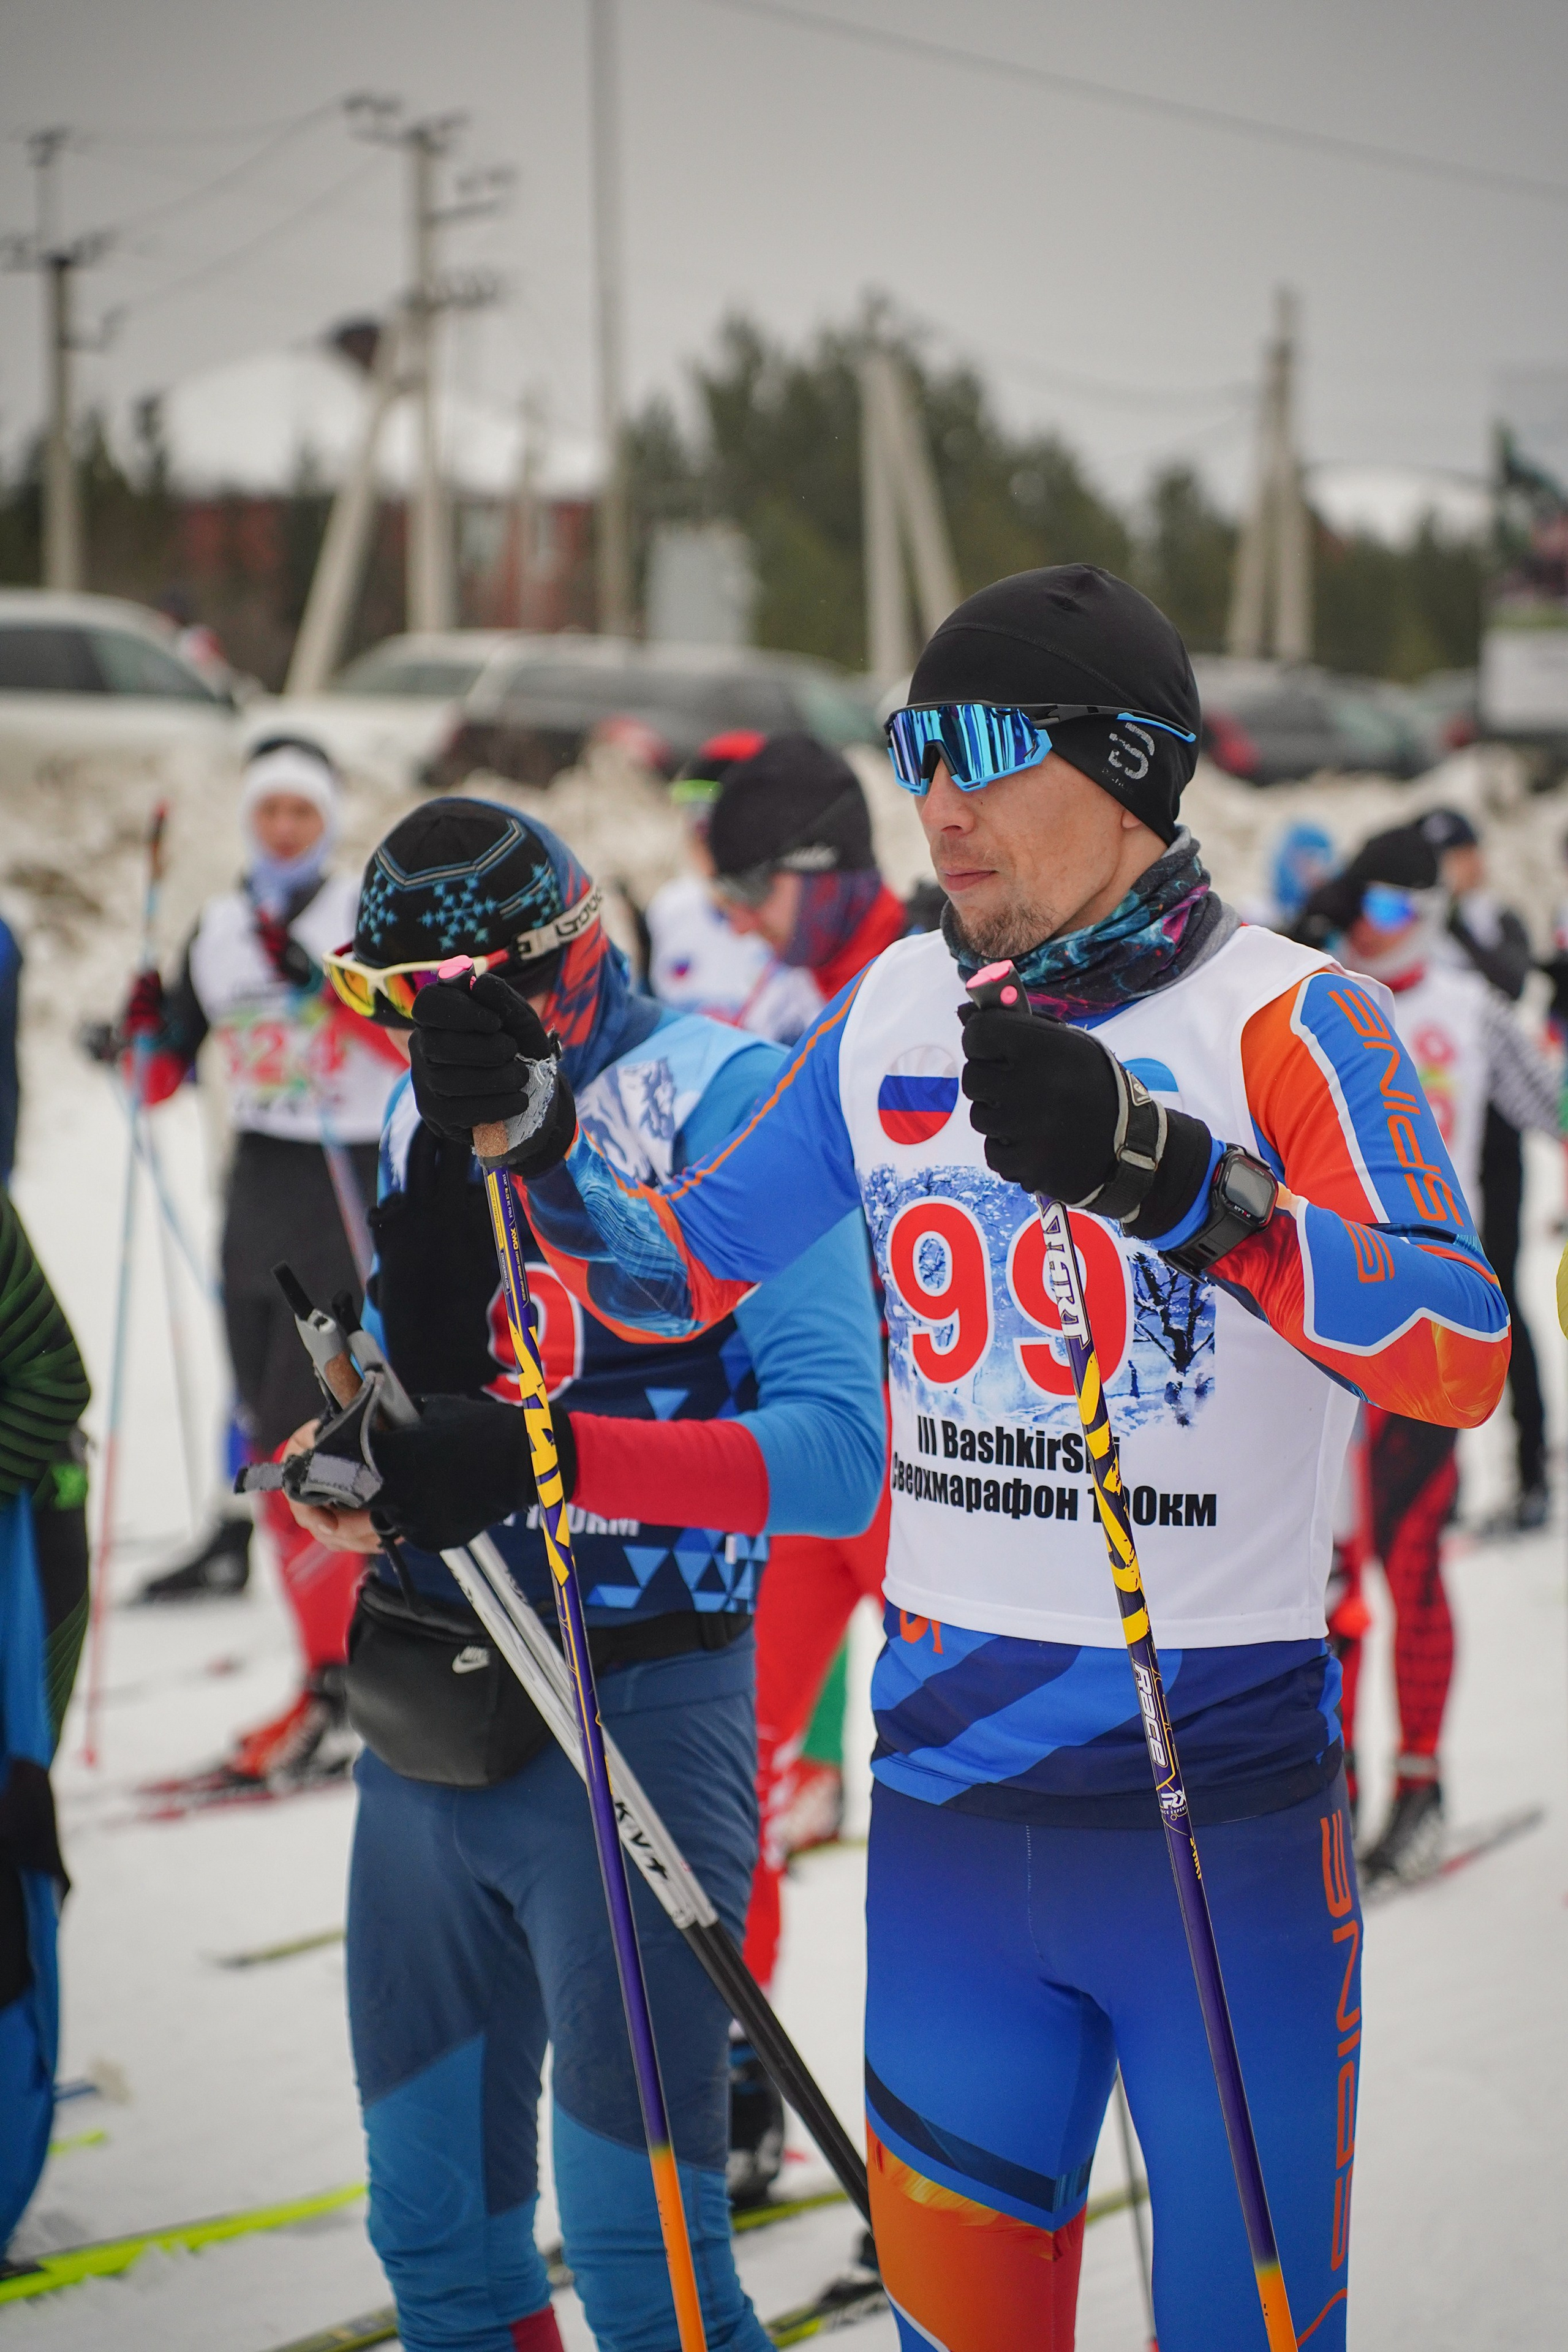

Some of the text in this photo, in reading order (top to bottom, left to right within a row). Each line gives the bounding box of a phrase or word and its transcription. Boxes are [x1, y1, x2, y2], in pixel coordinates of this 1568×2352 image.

[1233, 1204, 1251, 1219] POLAR
[890, 1197, 1132, 1397] 99
[916, 1415, 937, 1457] III
